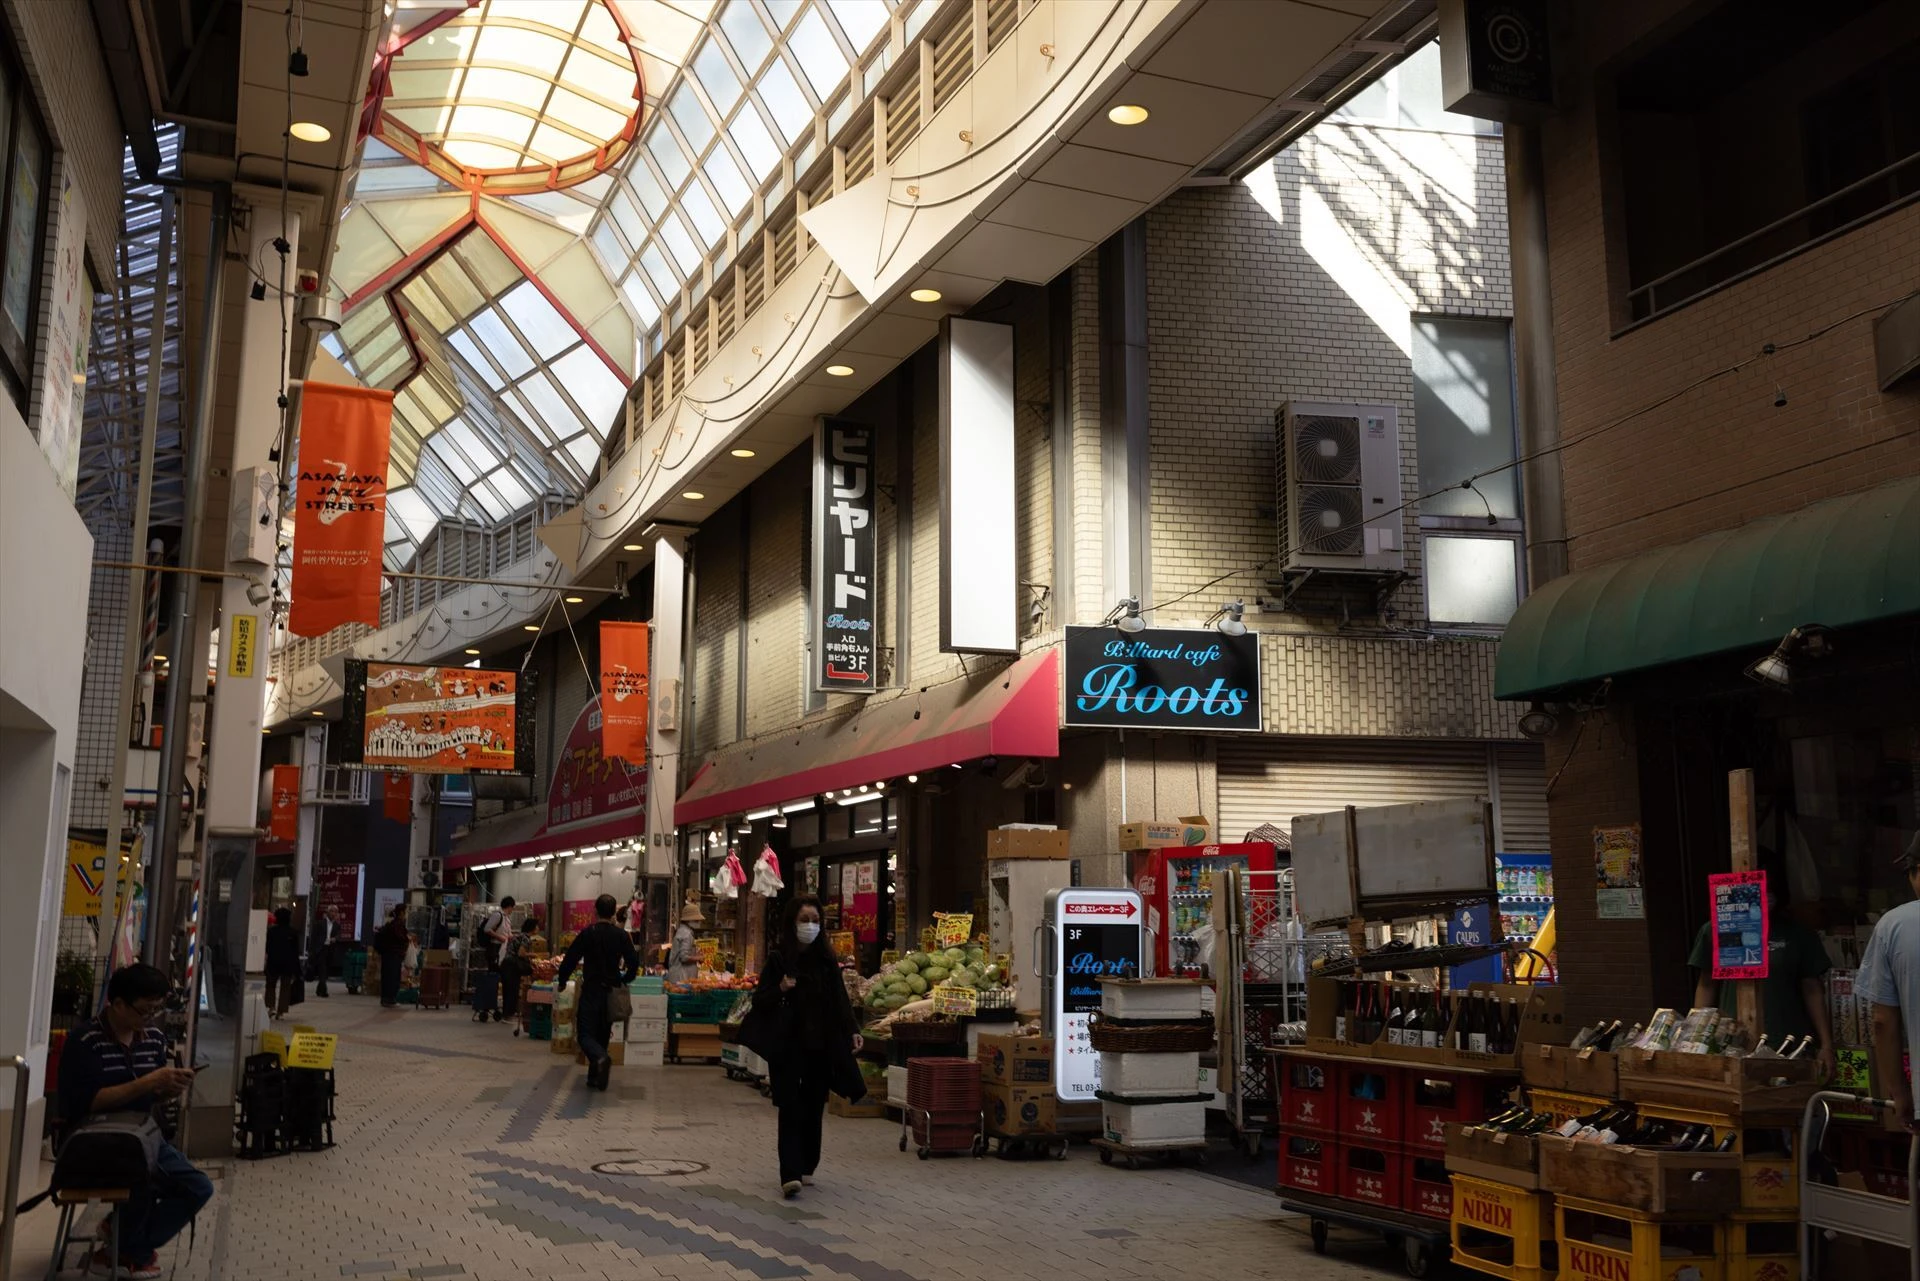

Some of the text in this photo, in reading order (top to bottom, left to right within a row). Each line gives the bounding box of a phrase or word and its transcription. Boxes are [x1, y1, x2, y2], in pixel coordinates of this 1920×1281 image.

[301, 472, 384, 485] ASAGAYA
[317, 487, 366, 497] JAZZ
[305, 501, 375, 512] STREETS
[830, 429, 869, 608] ビリヤード
[826, 614, 870, 630] Roots
[236, 619, 249, 673] 防犯カメラ作動中
[841, 635, 856, 643] 入口
[826, 643, 870, 653] 手前角右入ル
[1104, 640, 1183, 659] Billiard
[848, 655, 868, 670] 3F
[1077, 663, 1248, 716] Roots
[1070, 930, 1082, 940] 3F
[1456, 931, 1480, 944] CALPIS
[1072, 1084, 1084, 1092] TEL
[1462, 1198, 1513, 1230] KIRIN
[1570, 1248, 1630, 1281] KIRIN
